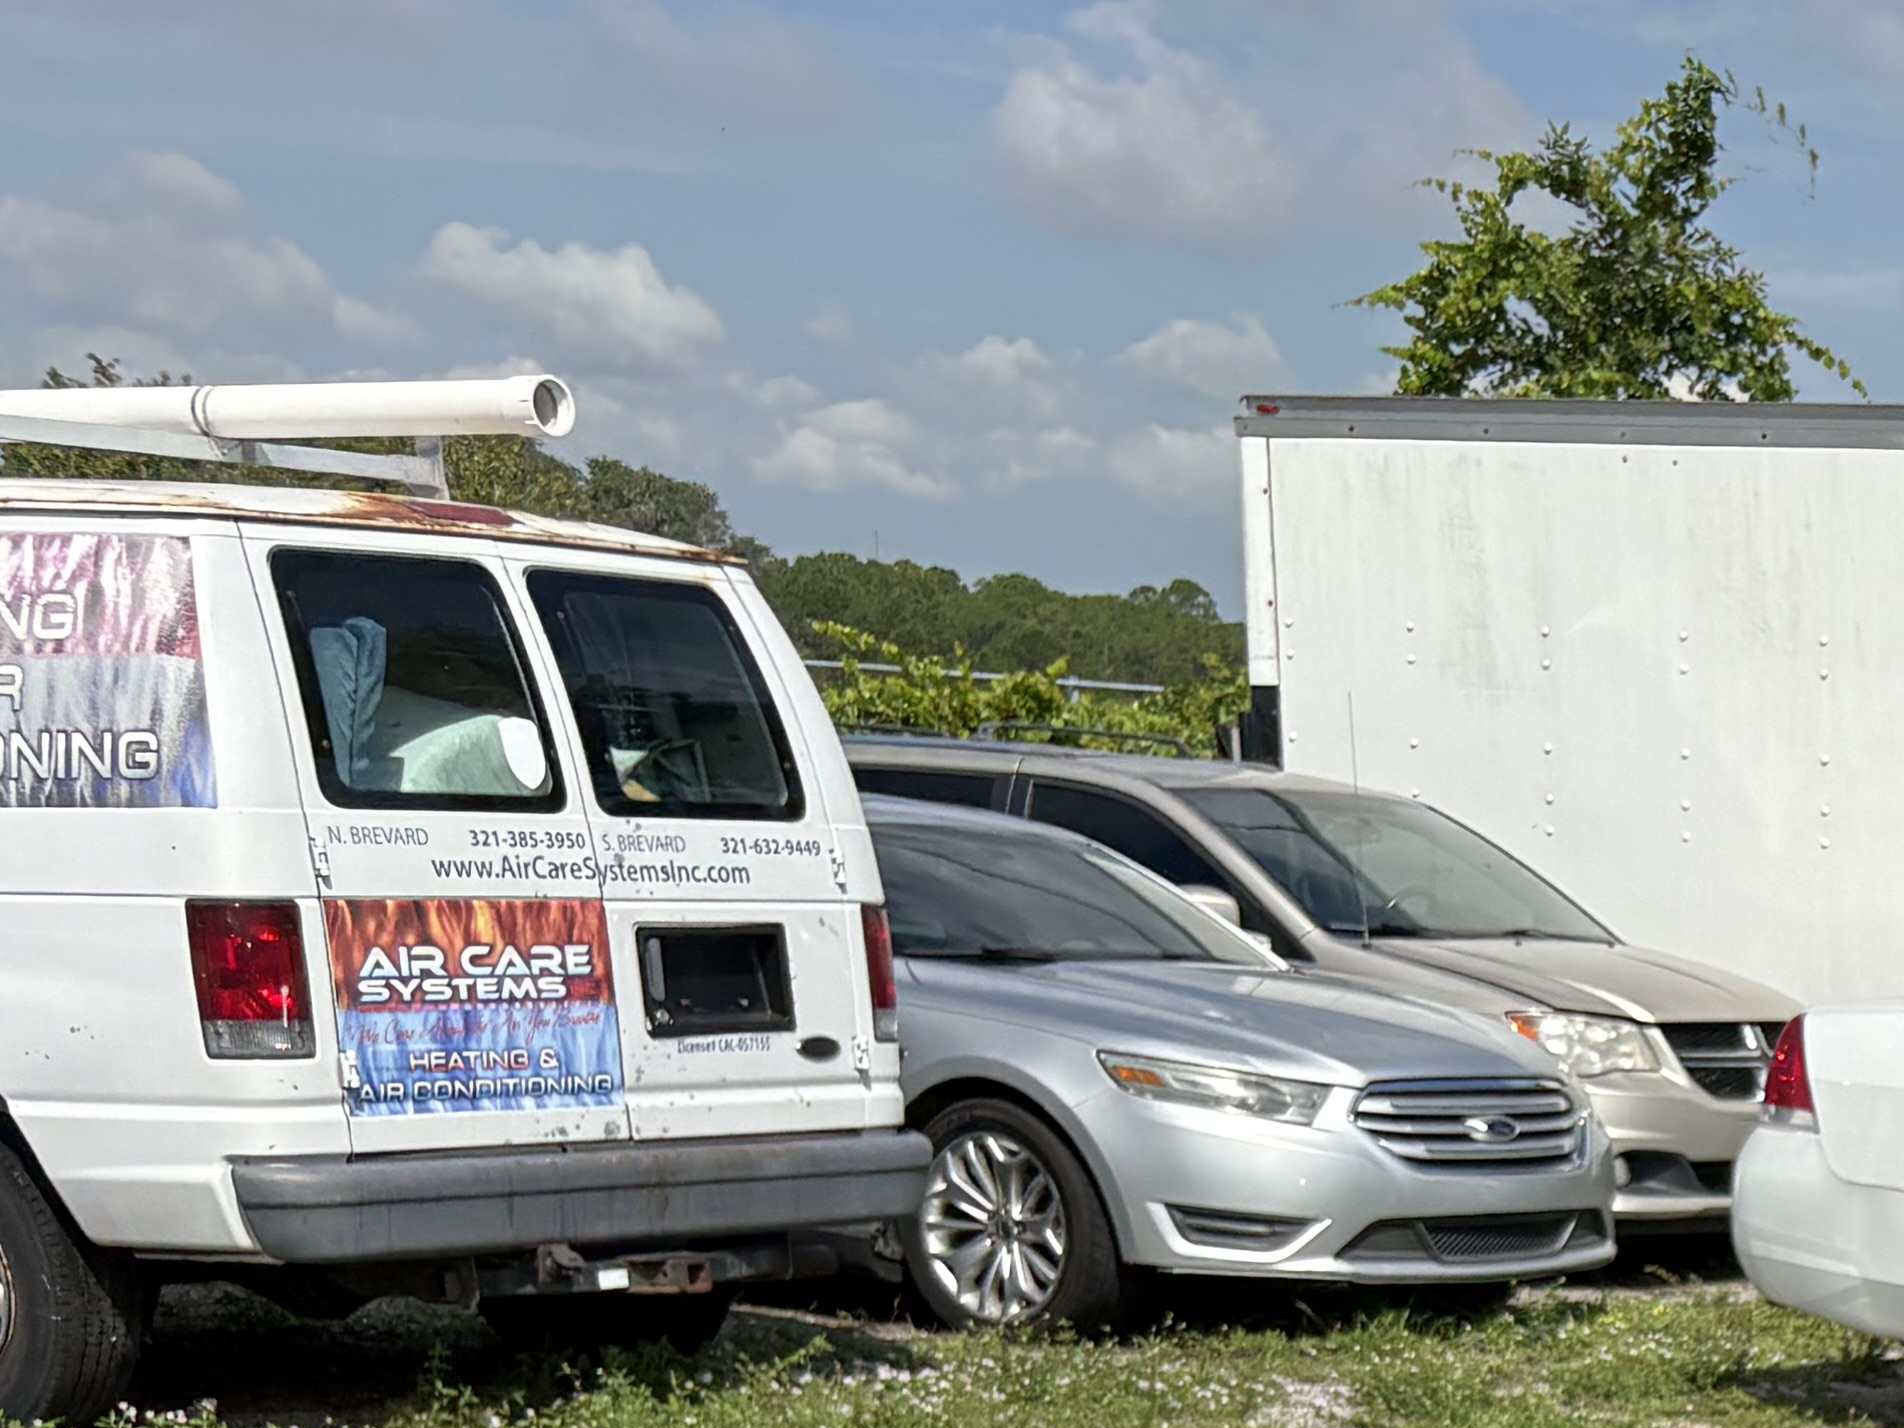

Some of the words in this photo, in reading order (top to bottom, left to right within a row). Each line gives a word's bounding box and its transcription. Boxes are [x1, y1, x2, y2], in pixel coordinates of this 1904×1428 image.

[0, 731, 158, 780] NING
[327, 826, 347, 845] N.
[351, 827, 429, 846] BREVARD
[469, 829, 585, 850] 321-385-3950
[602, 834, 615, 851] S.
[618, 835, 686, 853] BREVARD
[720, 837, 821, 856] 321-632-9449
[431, 854, 750, 888] www.AirCareSystemsInc.com
[359, 945, 446, 977] AIR
[460, 944, 592, 976] CARE
[357, 976, 567, 1003] SYSTEMS
[409, 1049, 529, 1073] HEATING
[539, 1048, 559, 1068] &
[359, 1082, 404, 1102] AIR
[413, 1073, 613, 1100] CONDITIONING
